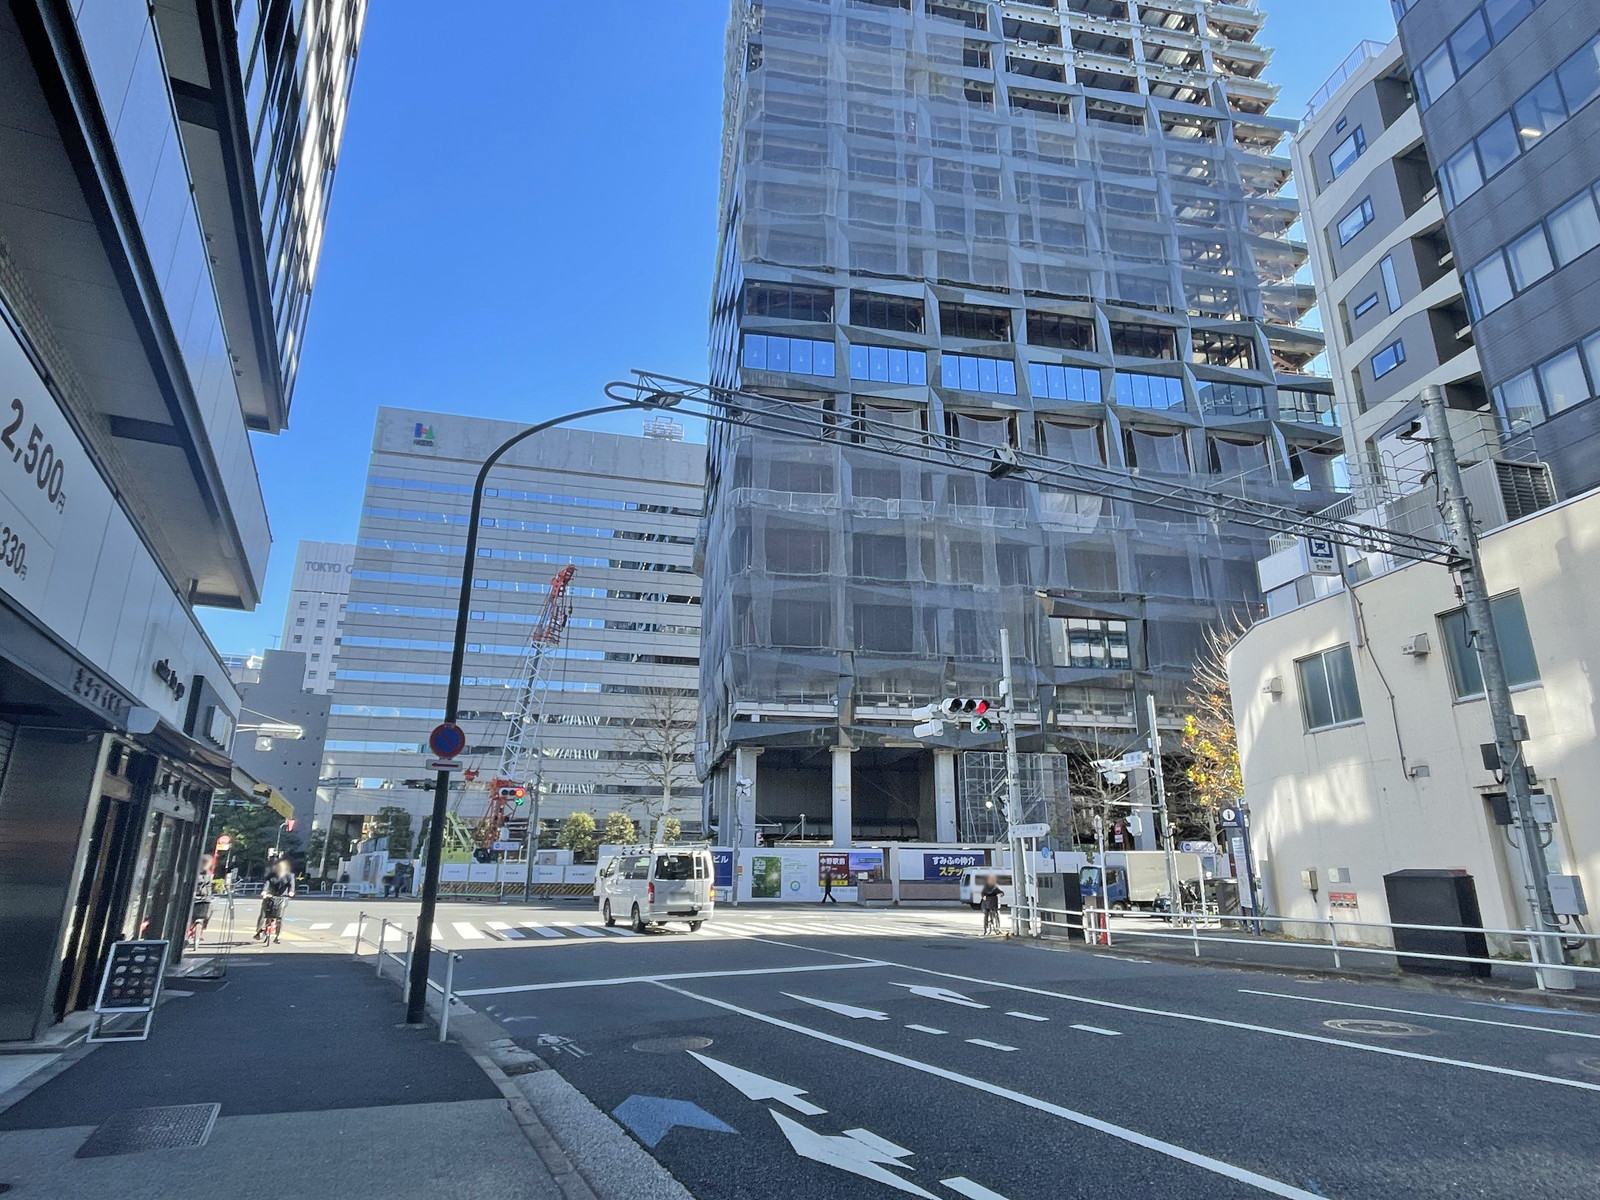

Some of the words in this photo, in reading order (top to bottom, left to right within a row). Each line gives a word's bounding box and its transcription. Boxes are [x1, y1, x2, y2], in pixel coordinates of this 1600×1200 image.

[305, 561, 341, 573] TOKYO
[346, 564, 353, 574] G
[932, 856, 976, 866] すみふの仲介
[939, 867, 963, 876] ステッ
